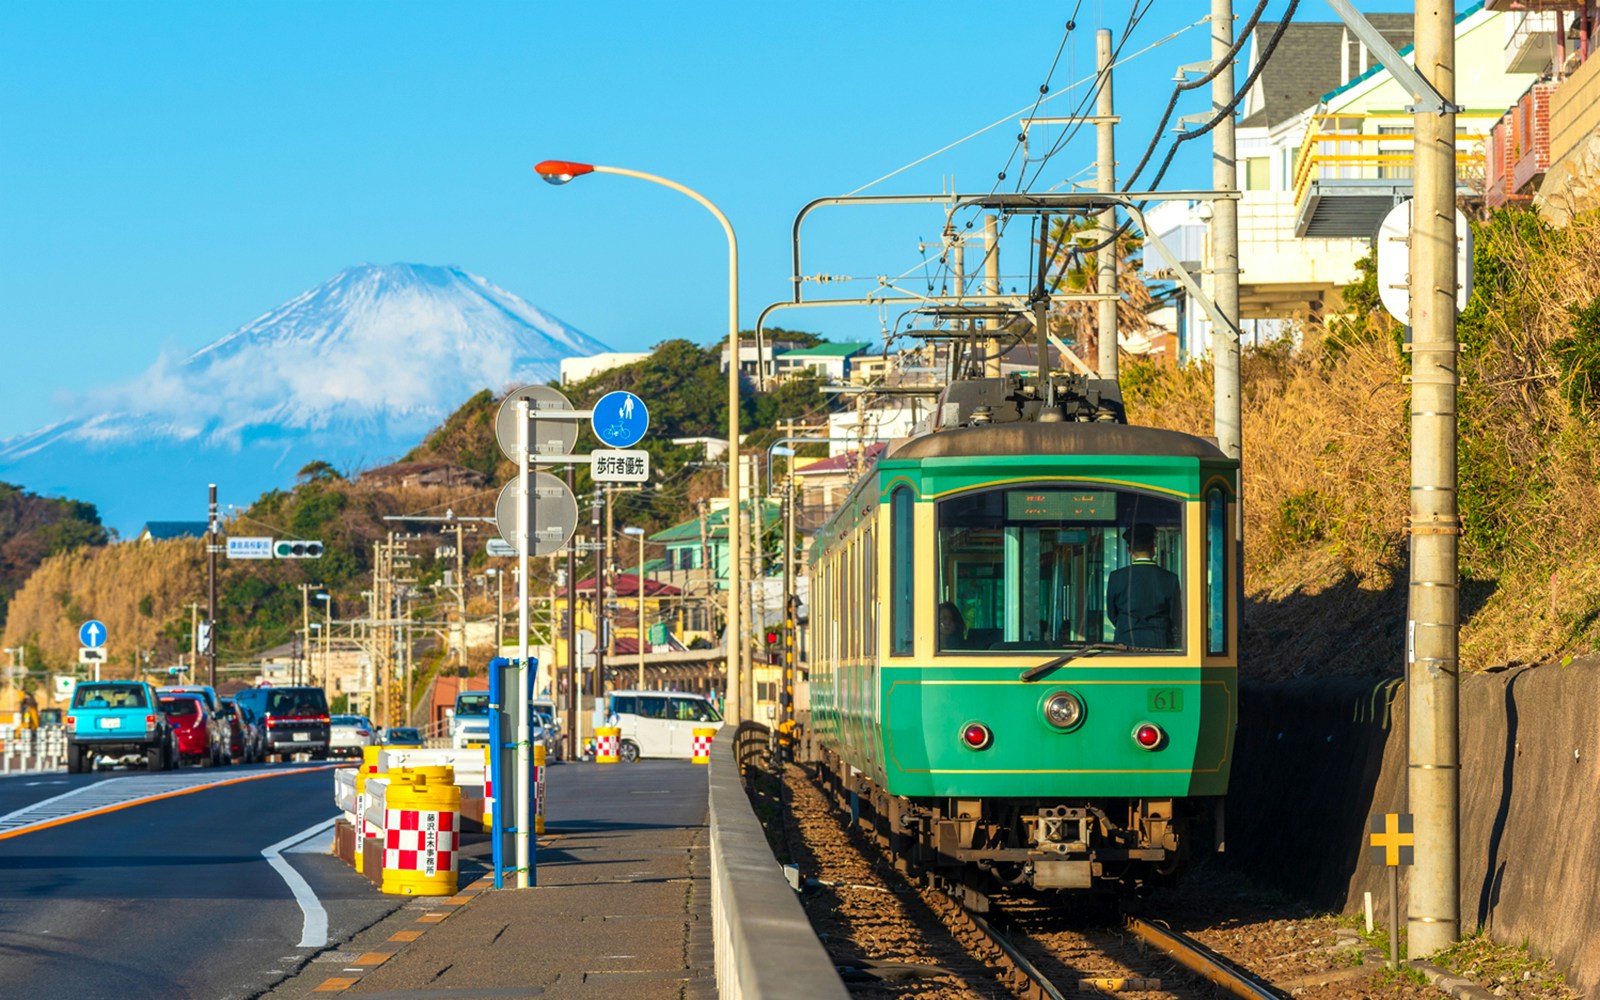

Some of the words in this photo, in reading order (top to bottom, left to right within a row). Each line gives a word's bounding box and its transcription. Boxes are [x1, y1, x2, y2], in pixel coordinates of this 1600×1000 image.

[597, 457, 644, 475] 歩行者優先
[1154, 691, 1175, 710] 61
[426, 813, 435, 875] 藤沢土木事務所
